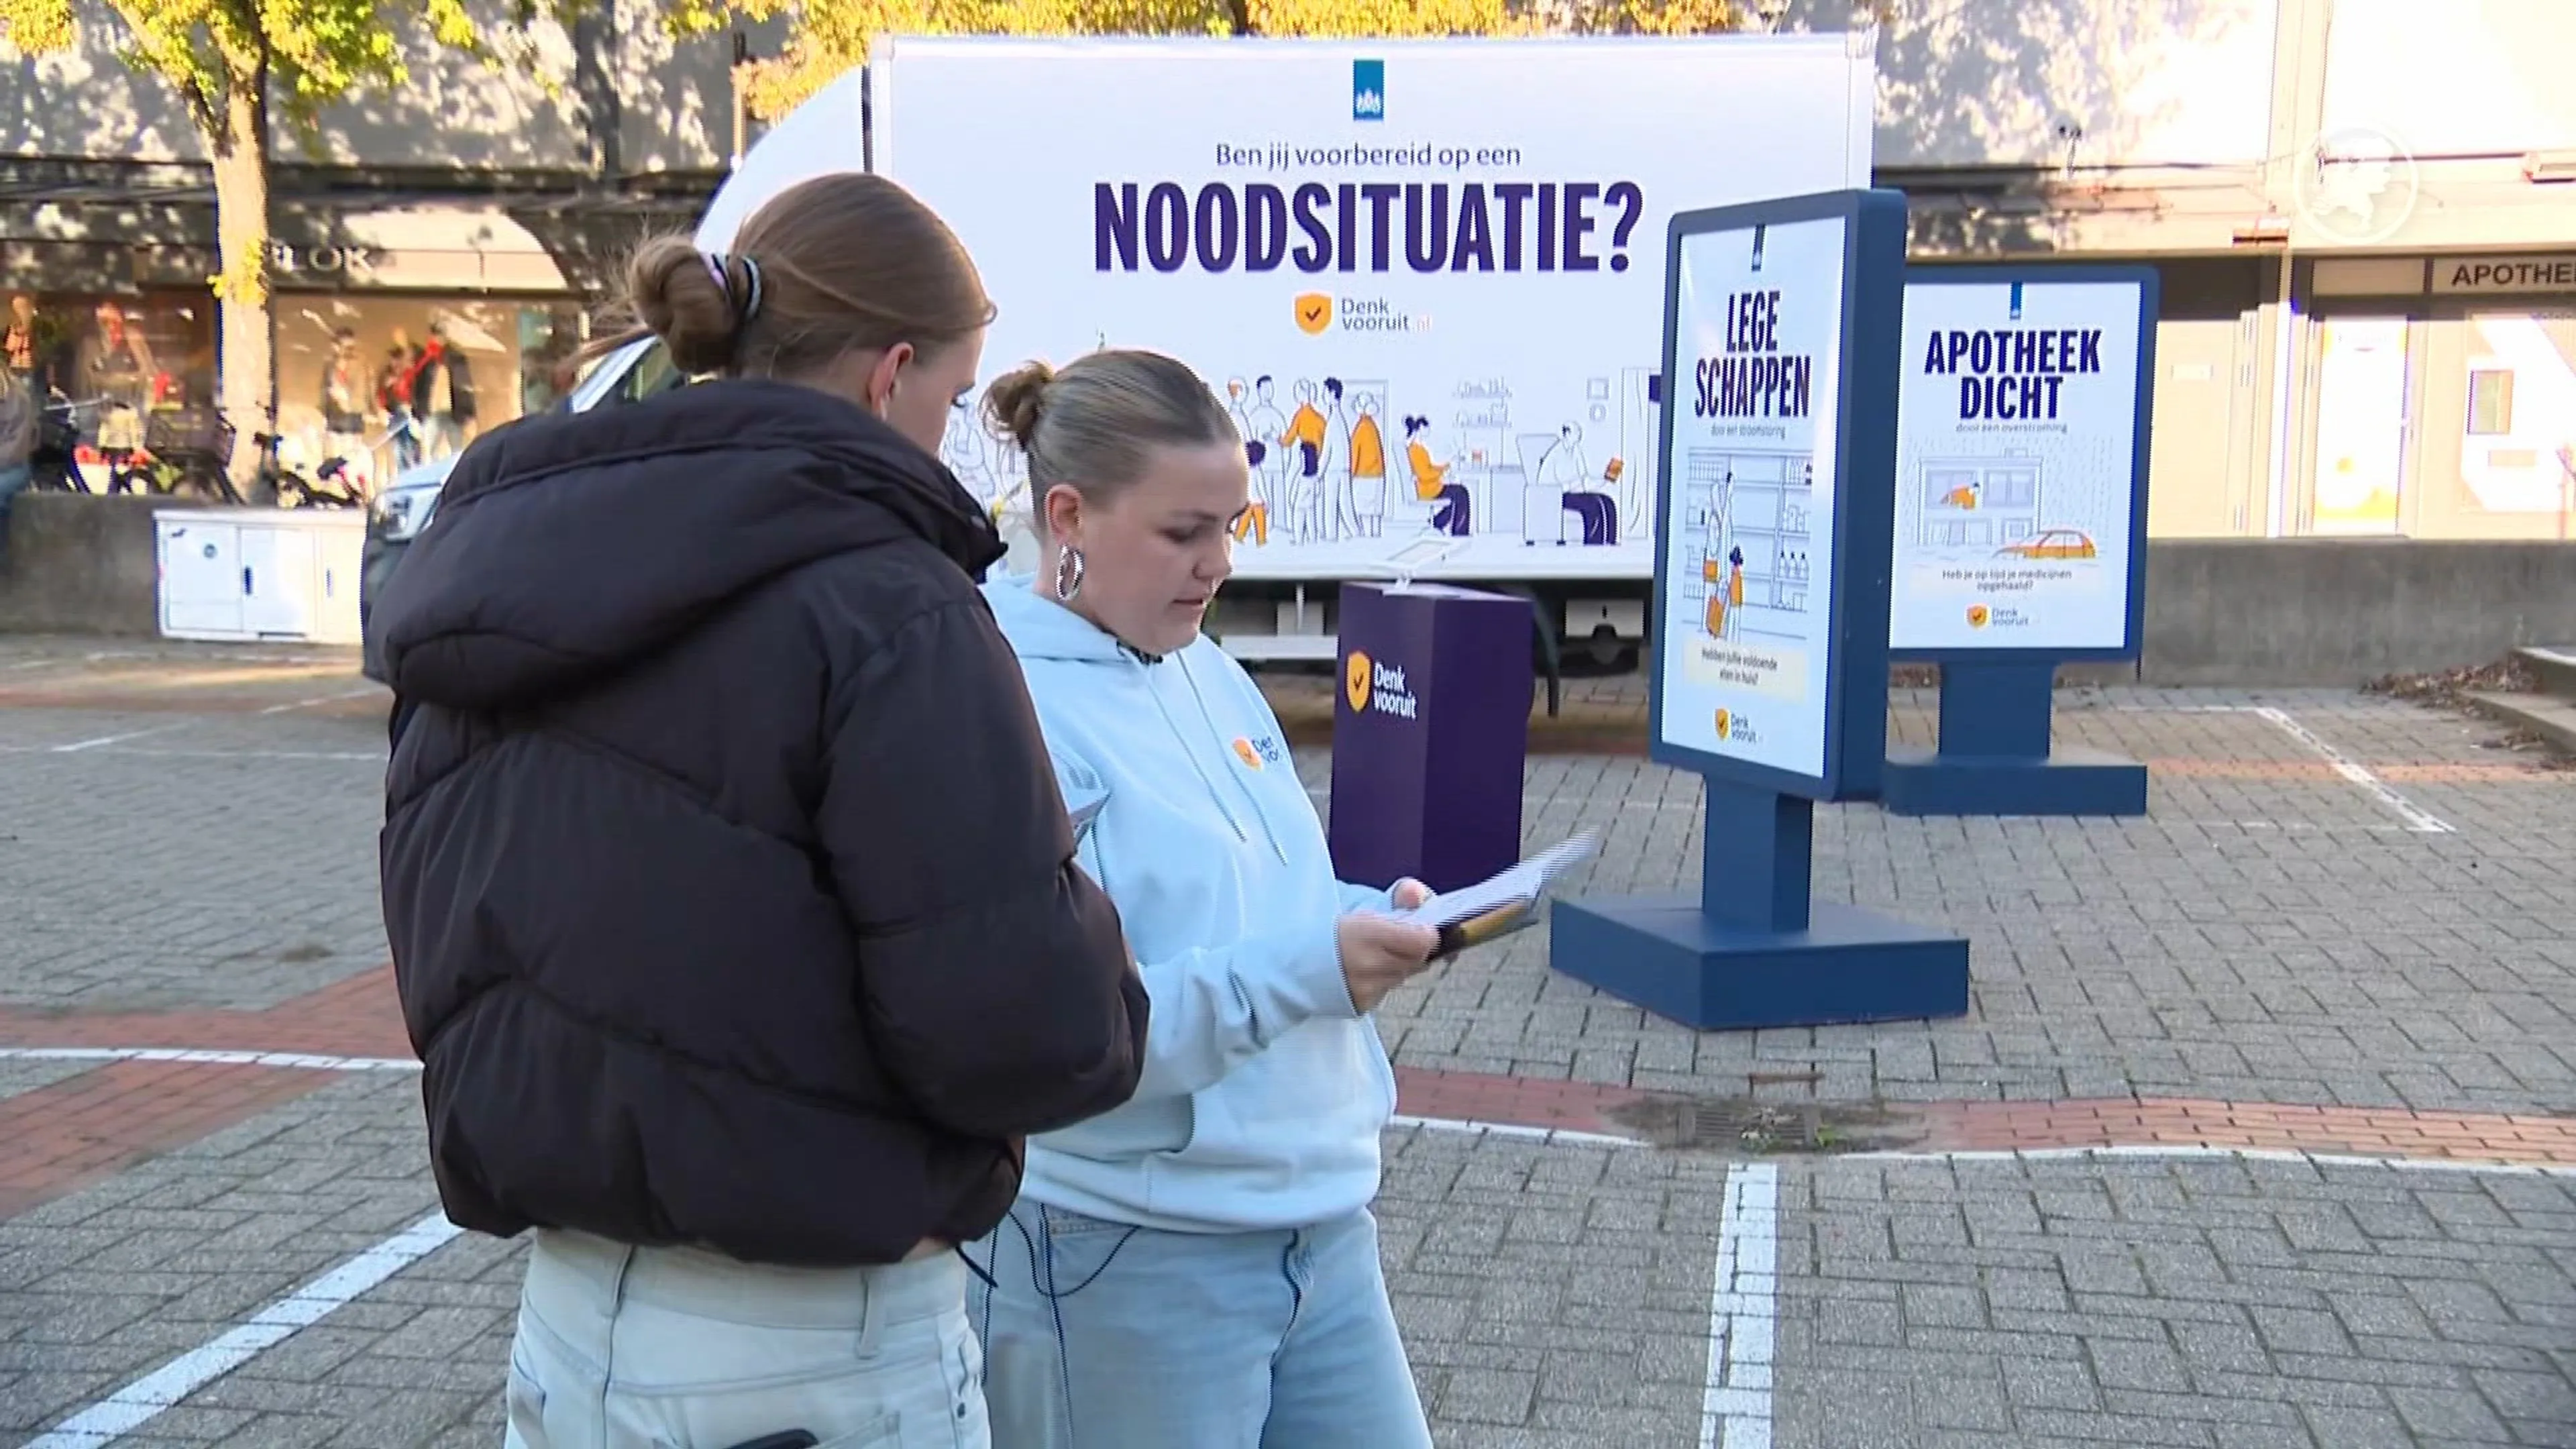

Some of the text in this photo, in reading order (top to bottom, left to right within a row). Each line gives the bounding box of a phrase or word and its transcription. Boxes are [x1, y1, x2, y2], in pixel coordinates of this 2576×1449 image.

[1216, 141, 1521, 172] Ben jij voorbereid op een
[1094, 181, 1643, 274] NOODSITUATIE?
[2451, 262, 2576, 286] APOTHE
[1341, 296, 1390, 315] Denk
[1726, 290, 1780, 353] LEGE
[1925, 329, 2102, 374] APOTHEEK
[1695, 356, 1811, 418] SCHAPPEN
[1960, 376, 2064, 420] DICHT
[1374, 661, 1406, 692] Denk
[1373, 688, 1417, 722] vooruit
